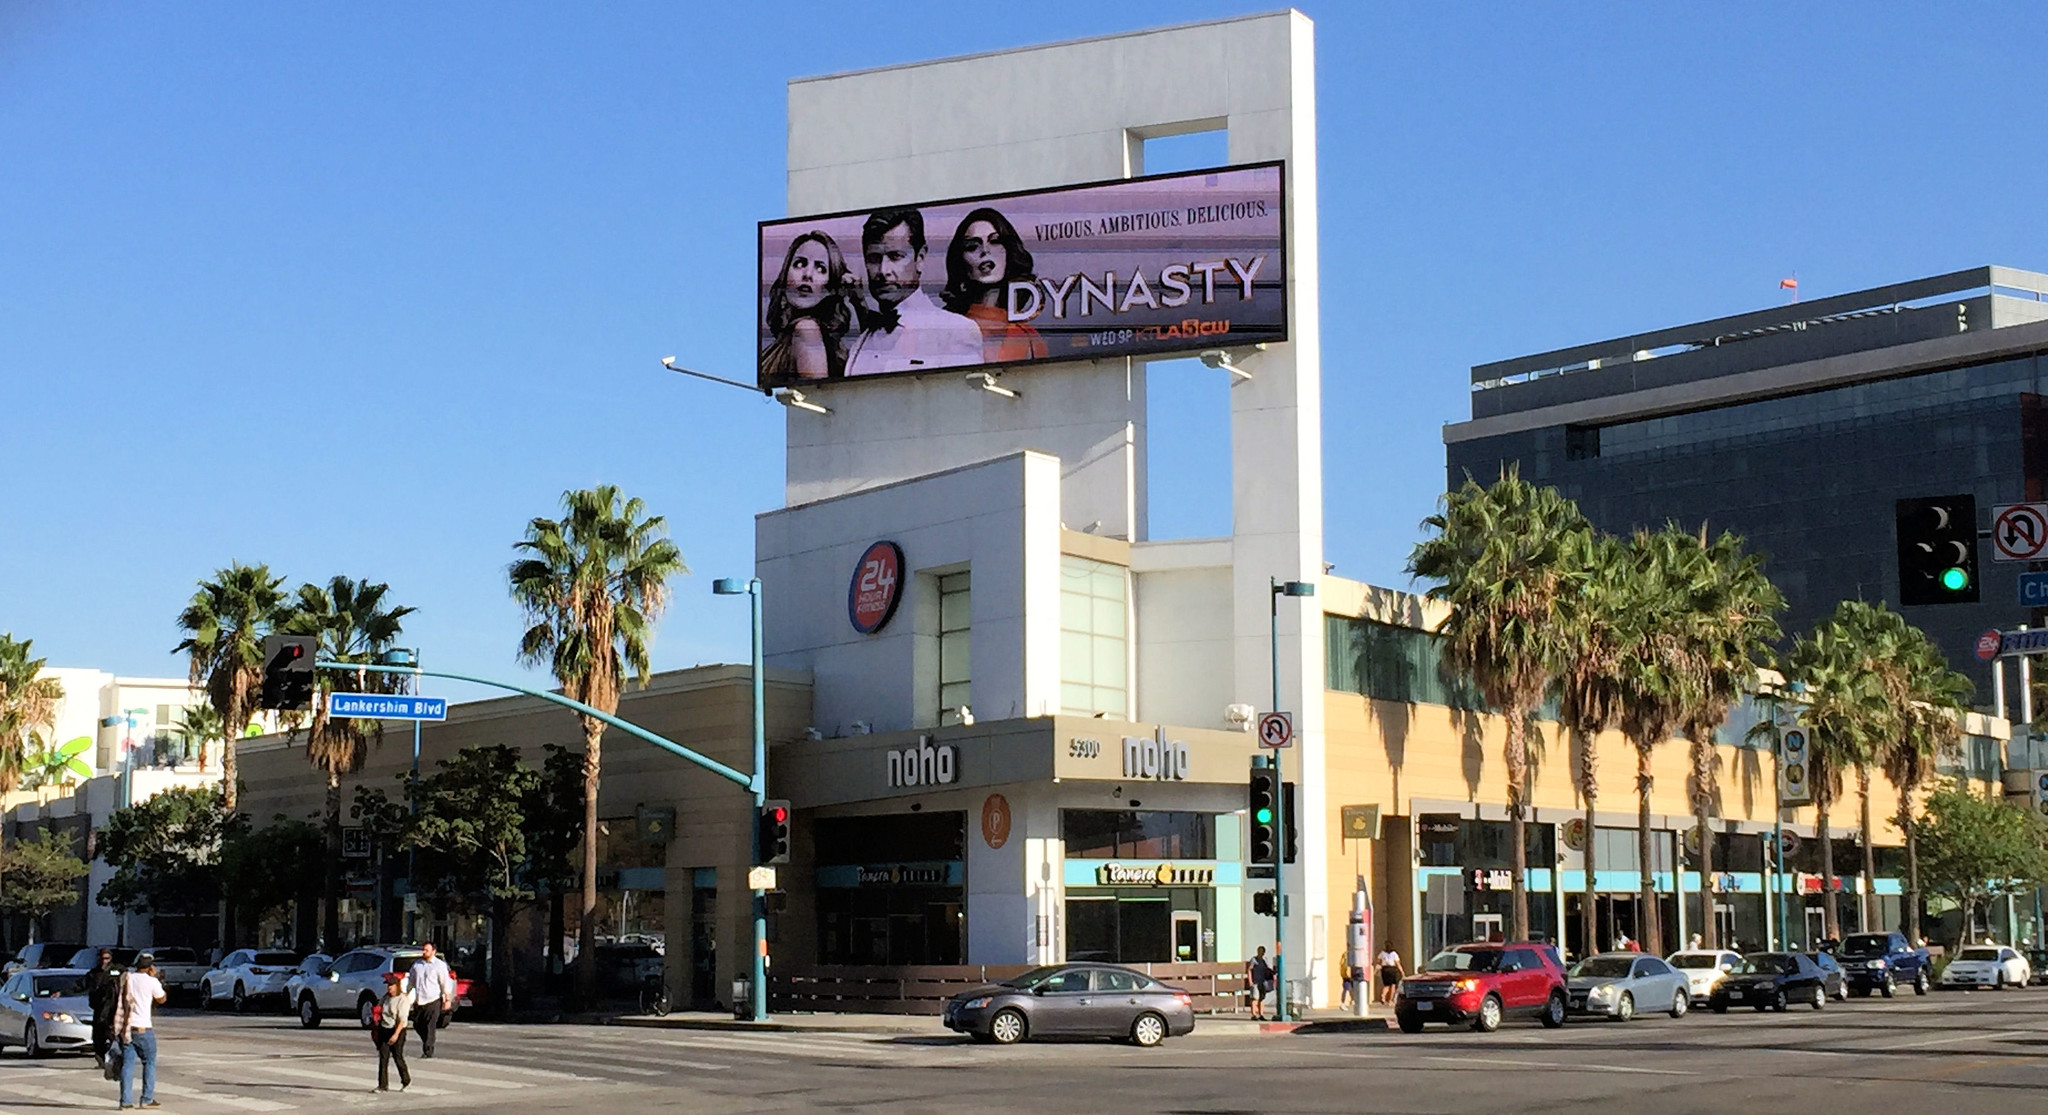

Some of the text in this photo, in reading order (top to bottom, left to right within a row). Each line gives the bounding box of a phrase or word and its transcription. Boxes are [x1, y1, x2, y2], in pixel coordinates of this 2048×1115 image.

[1035, 200, 1269, 242] VICIOUS. AMBITIOUS. DELICIOUS.
[1007, 254, 1267, 323] DYNASTY
[1090, 330, 1115, 346] WED
[1117, 329, 1133, 344] 9P
[861, 558, 895, 599] 24
[335, 698, 442, 715] Lankershim Blvd
[887, 735, 957, 787] noho
[1069, 738, 1100, 758] 5300
[1121, 725, 1189, 780] noho
[856, 866, 889, 882] Panera
[1106, 862, 1157, 881] Panera
